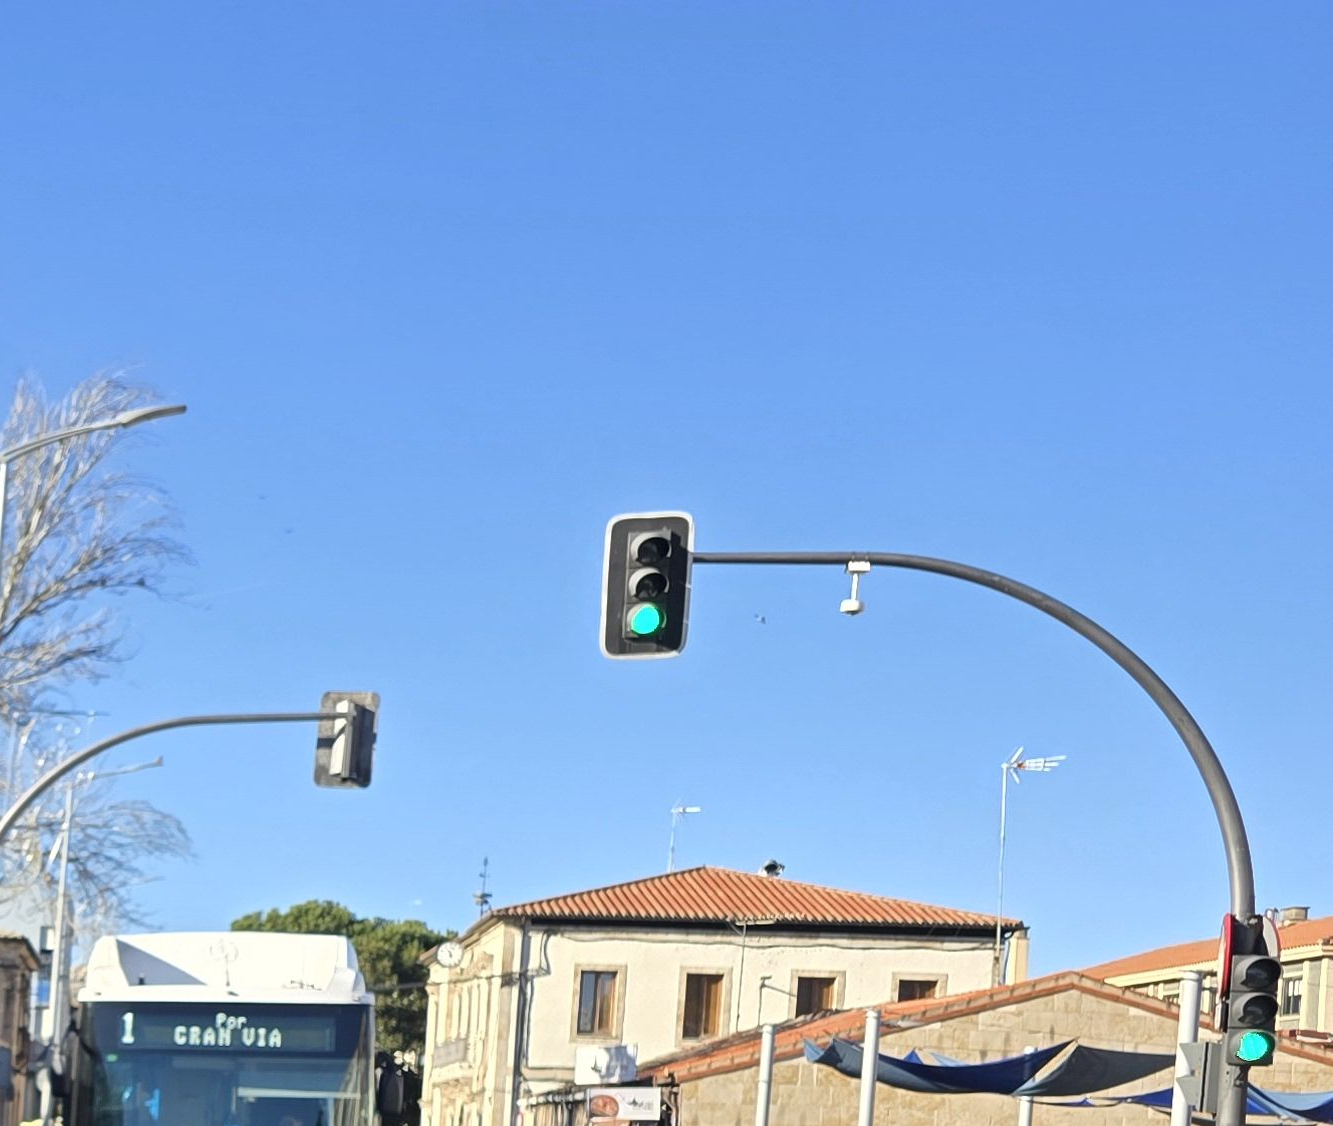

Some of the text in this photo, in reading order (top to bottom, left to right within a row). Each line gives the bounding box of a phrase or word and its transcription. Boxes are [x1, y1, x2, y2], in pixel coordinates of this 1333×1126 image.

[121, 1012, 135, 1044] 1
[215, 1012, 247, 1030] Por
[173, 1025, 282, 1048] GRAN VIA
